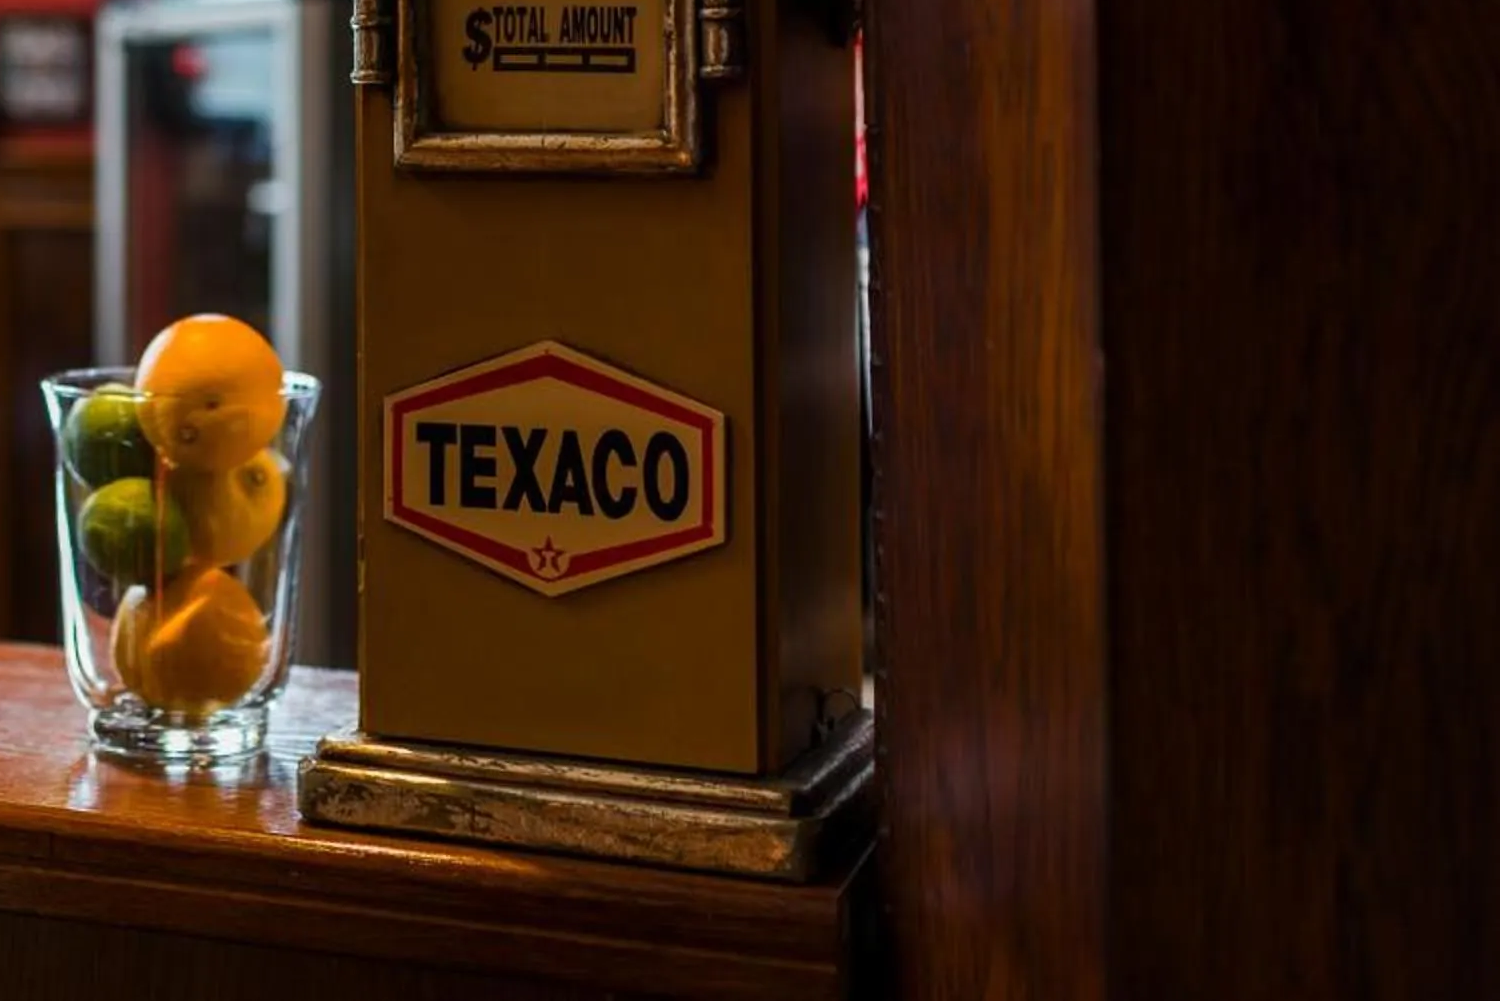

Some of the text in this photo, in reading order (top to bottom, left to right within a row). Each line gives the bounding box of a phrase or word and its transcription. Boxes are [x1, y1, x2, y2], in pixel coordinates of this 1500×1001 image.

[493, 5, 549, 44] TOTAL
[559, 5, 637, 44] AMOUNT
[416, 421, 689, 522] TEXACO
